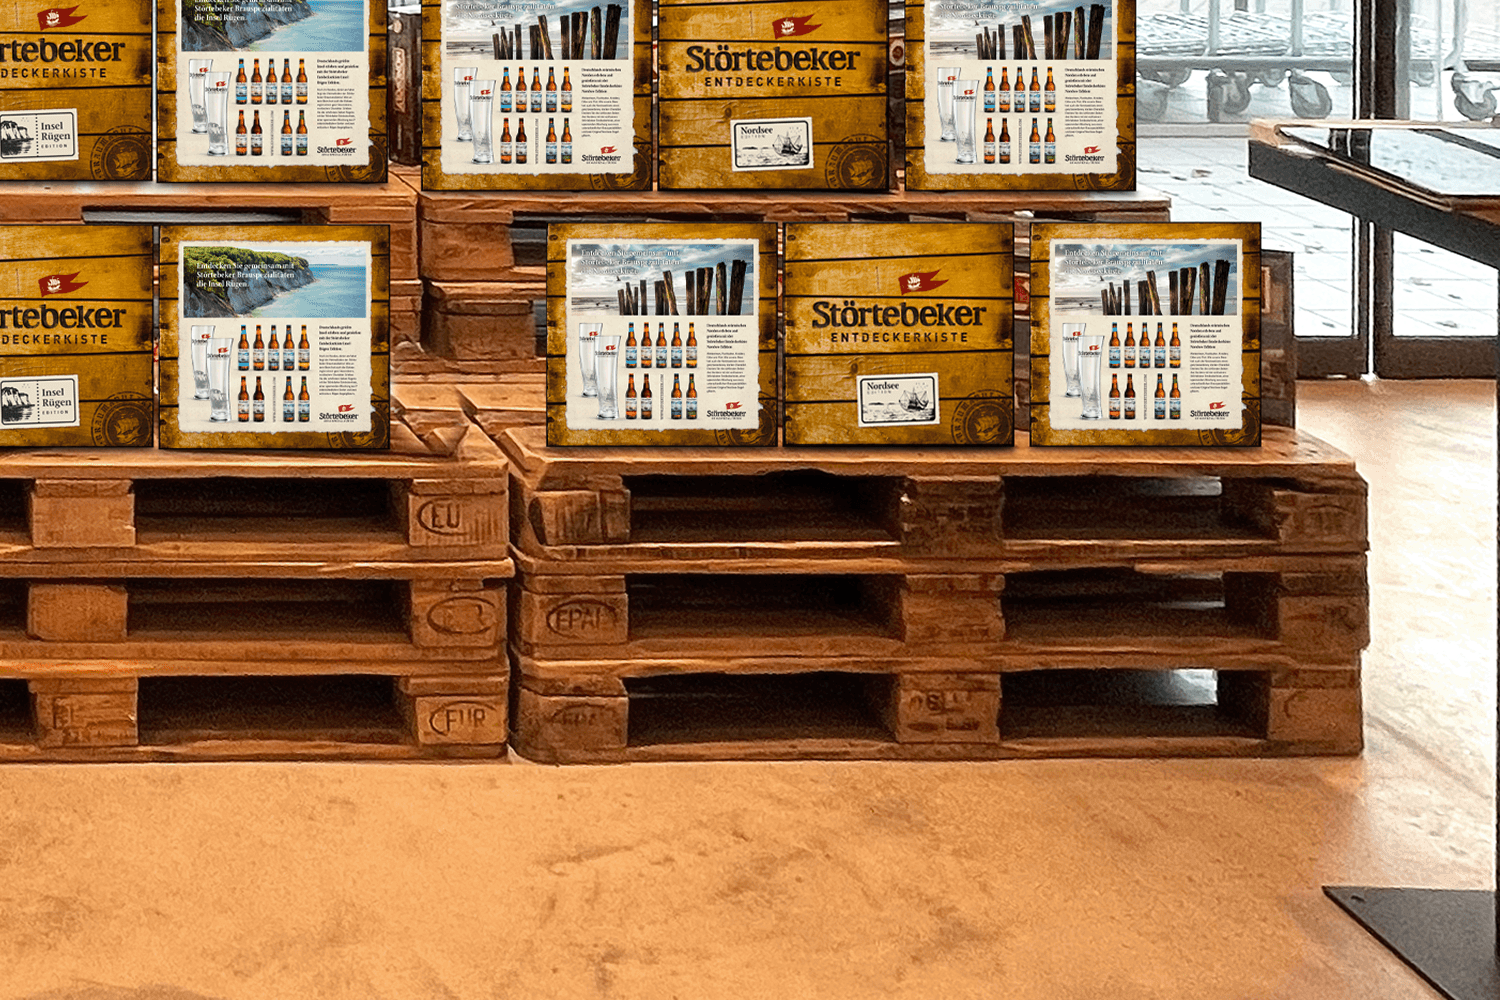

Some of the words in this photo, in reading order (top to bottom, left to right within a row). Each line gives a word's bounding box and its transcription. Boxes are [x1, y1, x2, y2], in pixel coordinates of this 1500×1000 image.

[686, 45, 861, 73] Störtebeker
[705, 77, 842, 88] ENTDECKERKISTE
[40, 122, 63, 131] Insel
[740, 126, 773, 135] Nordsee
[40, 132, 71, 143] Rügen
[812, 300, 987, 328] Störtebeker
[831, 332, 968, 343] ENTDECKERKISTE
[866, 381, 899, 390] Nordsee
[41, 388, 64, 397] Insel
[41, 398, 72, 409] Rügen
